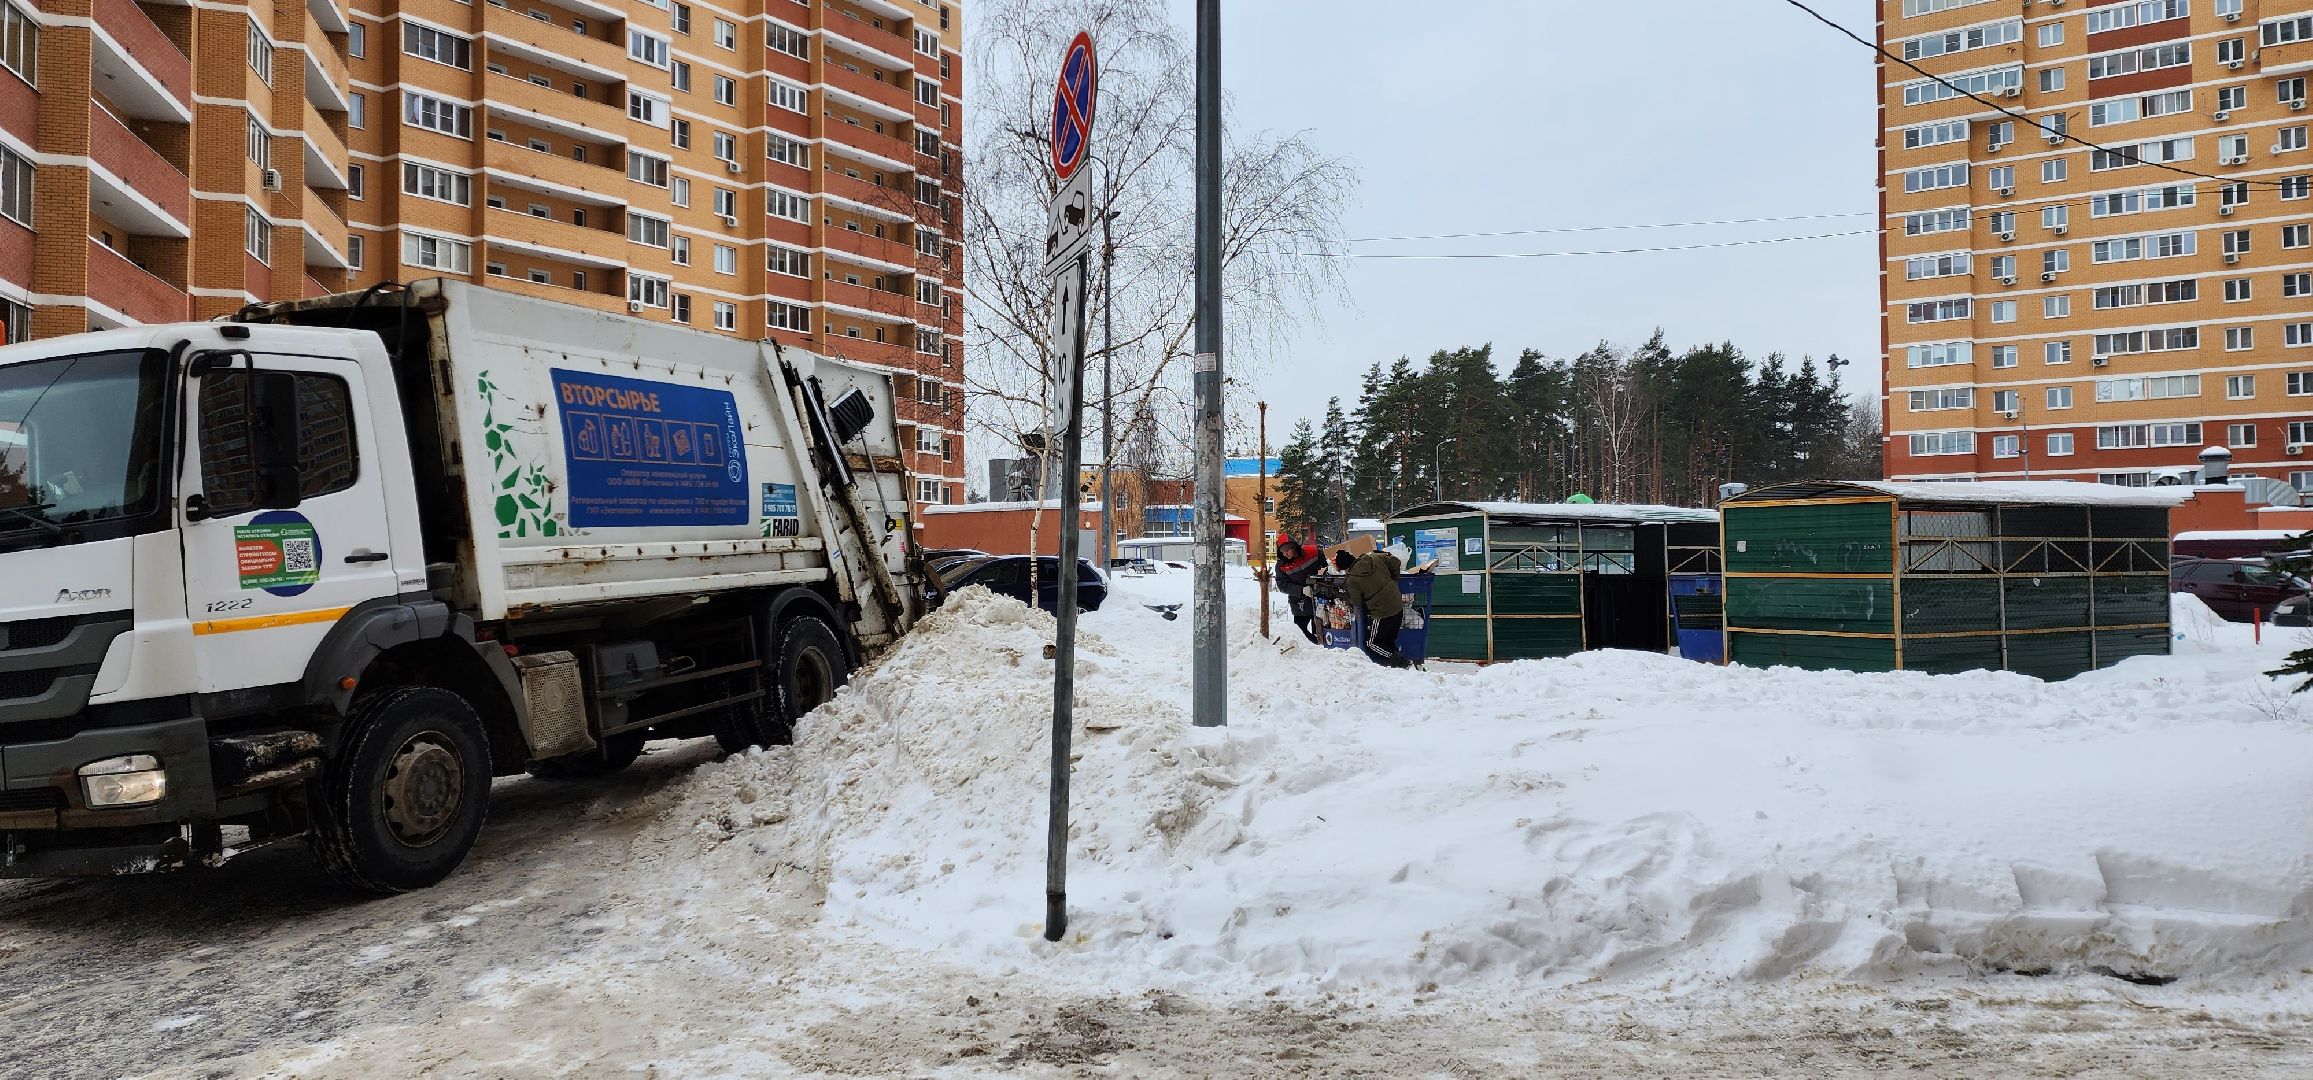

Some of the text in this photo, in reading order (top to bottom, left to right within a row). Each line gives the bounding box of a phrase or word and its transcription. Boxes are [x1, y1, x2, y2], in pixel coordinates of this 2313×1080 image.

[560, 382, 661, 412] ВТОРСЫРЬЕ
[773, 519, 799, 537] FARID
[205, 598, 253, 613] 1222
